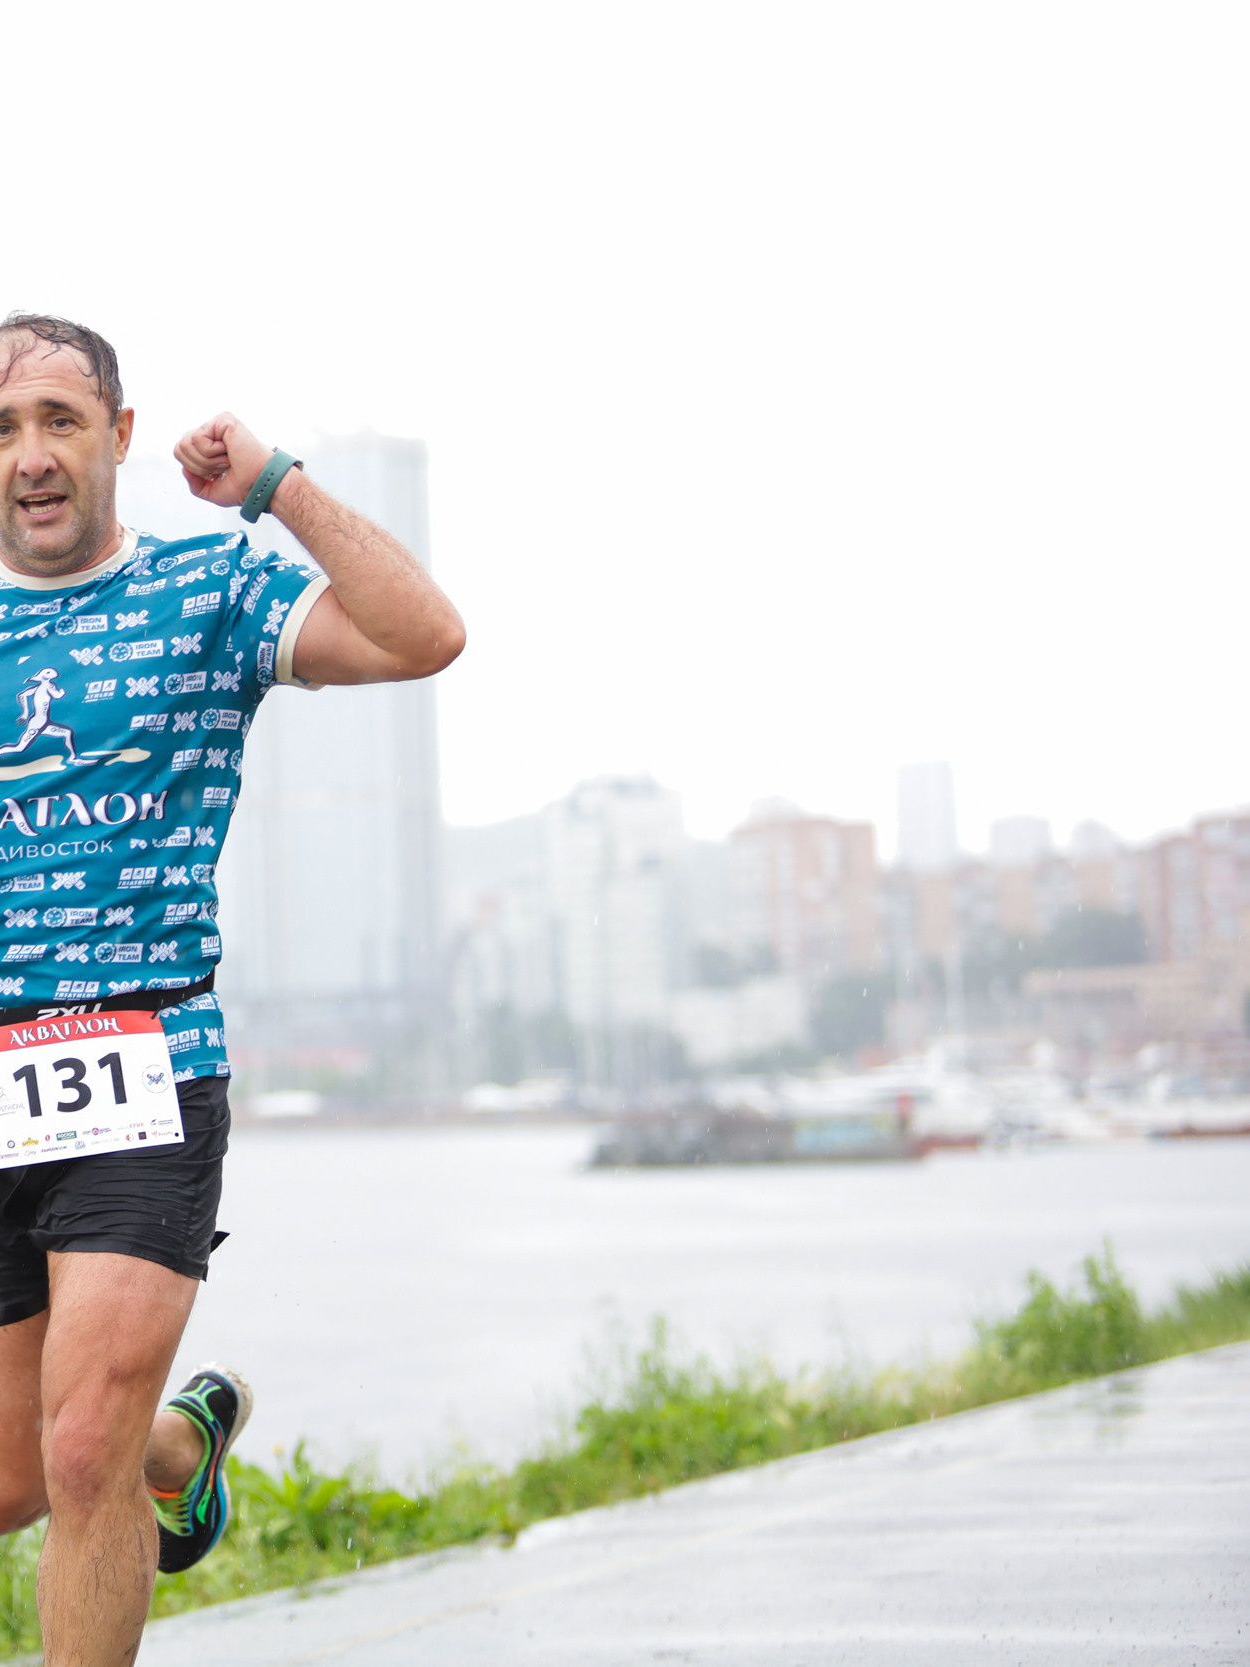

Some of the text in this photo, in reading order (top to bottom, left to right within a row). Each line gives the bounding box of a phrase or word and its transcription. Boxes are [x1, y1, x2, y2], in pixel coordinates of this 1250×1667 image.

[125, 584, 166, 595] TRIATHLON
[182, 604, 220, 616] TRIATHLON
[80, 617, 101, 625] IRON
[81, 624, 106, 632] TEAM
[135, 642, 157, 650] IRON
[135, 648, 161, 657] TEAM
[185, 674, 202, 682] IRON
[185, 681, 204, 691] TEAM
[221, 711, 237, 720] IRON
[220, 720, 238, 729] TEAM
[170, 837, 189, 845] TEAM
[17, 882, 42, 890] TEAM
[117, 879, 156, 887] TRIATHLON
[69, 910, 92, 918] IRON
[69, 917, 94, 925] TEAM
[117, 953, 140, 962] TEAM
[169, 980, 187, 988] IRON
[10, 1017, 124, 1047] АКВАТЛОН
[12, 1052, 128, 1118] 131
